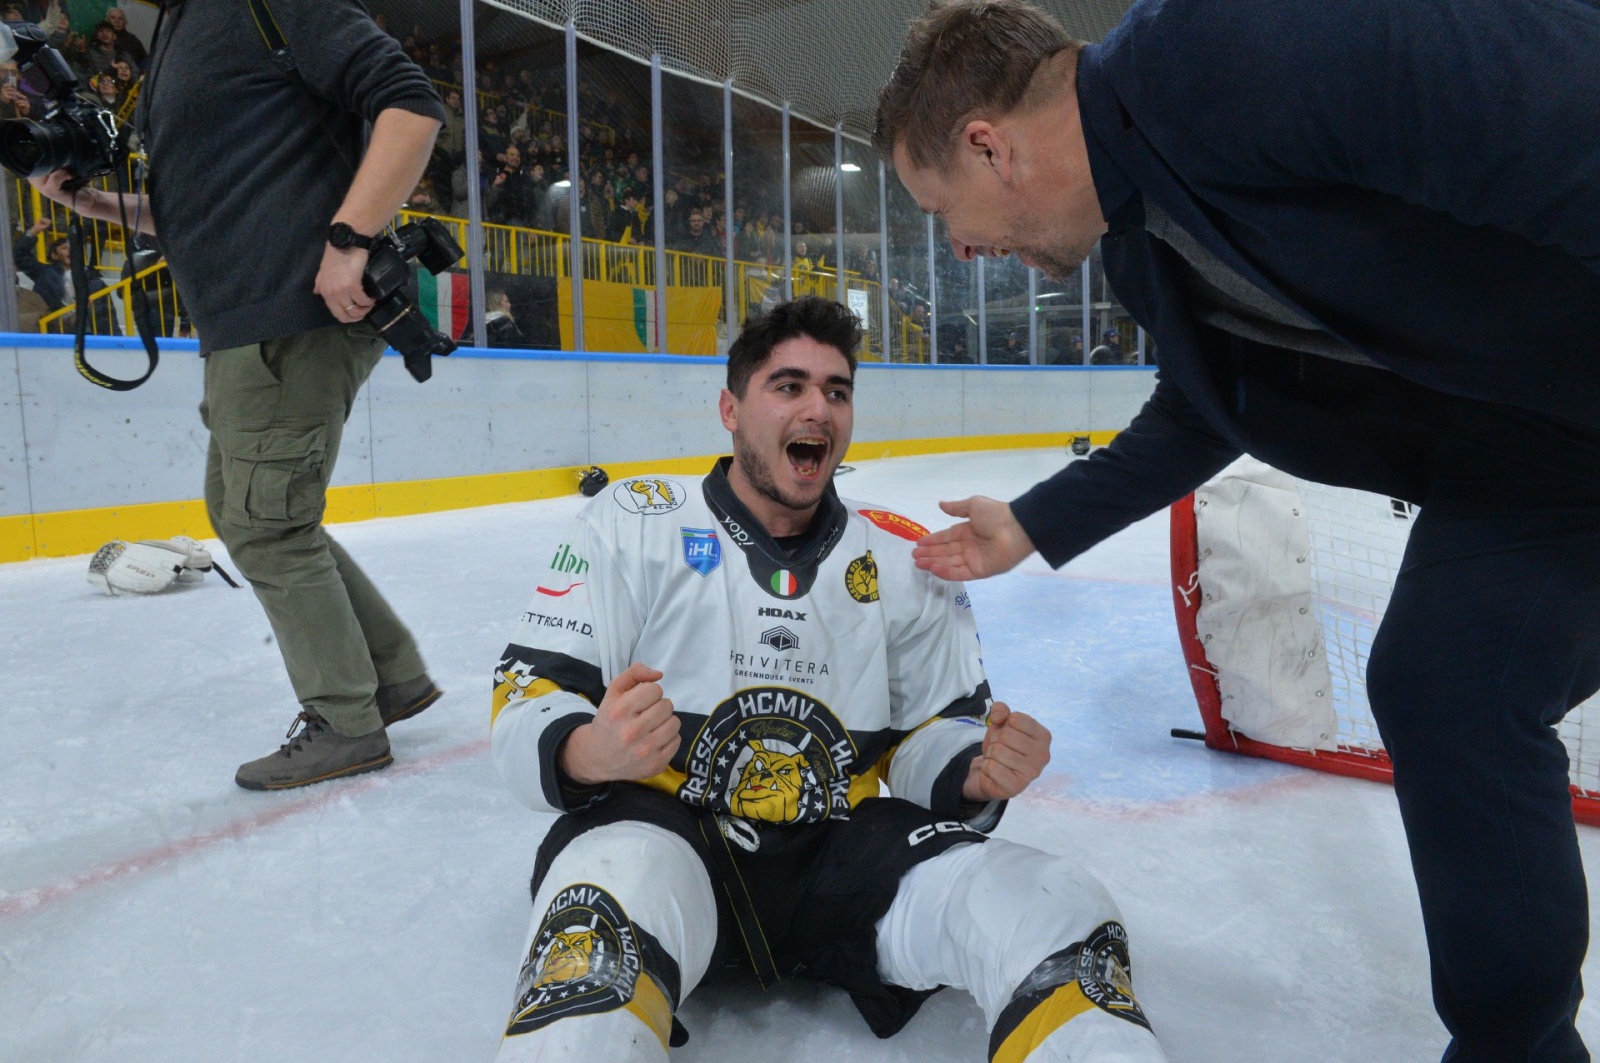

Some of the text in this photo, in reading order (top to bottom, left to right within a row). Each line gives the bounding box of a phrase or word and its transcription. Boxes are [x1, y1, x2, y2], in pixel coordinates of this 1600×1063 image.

[521, 611, 564, 628] TTRICA
[757, 606, 808, 621] HOAX
[680, 727, 719, 806] ARESE
[737, 692, 815, 721] HCMV
[547, 887, 601, 921] HCMV
[616, 926, 640, 1002] HOCKEY
[1079, 924, 1129, 1003] VARESE HCM
